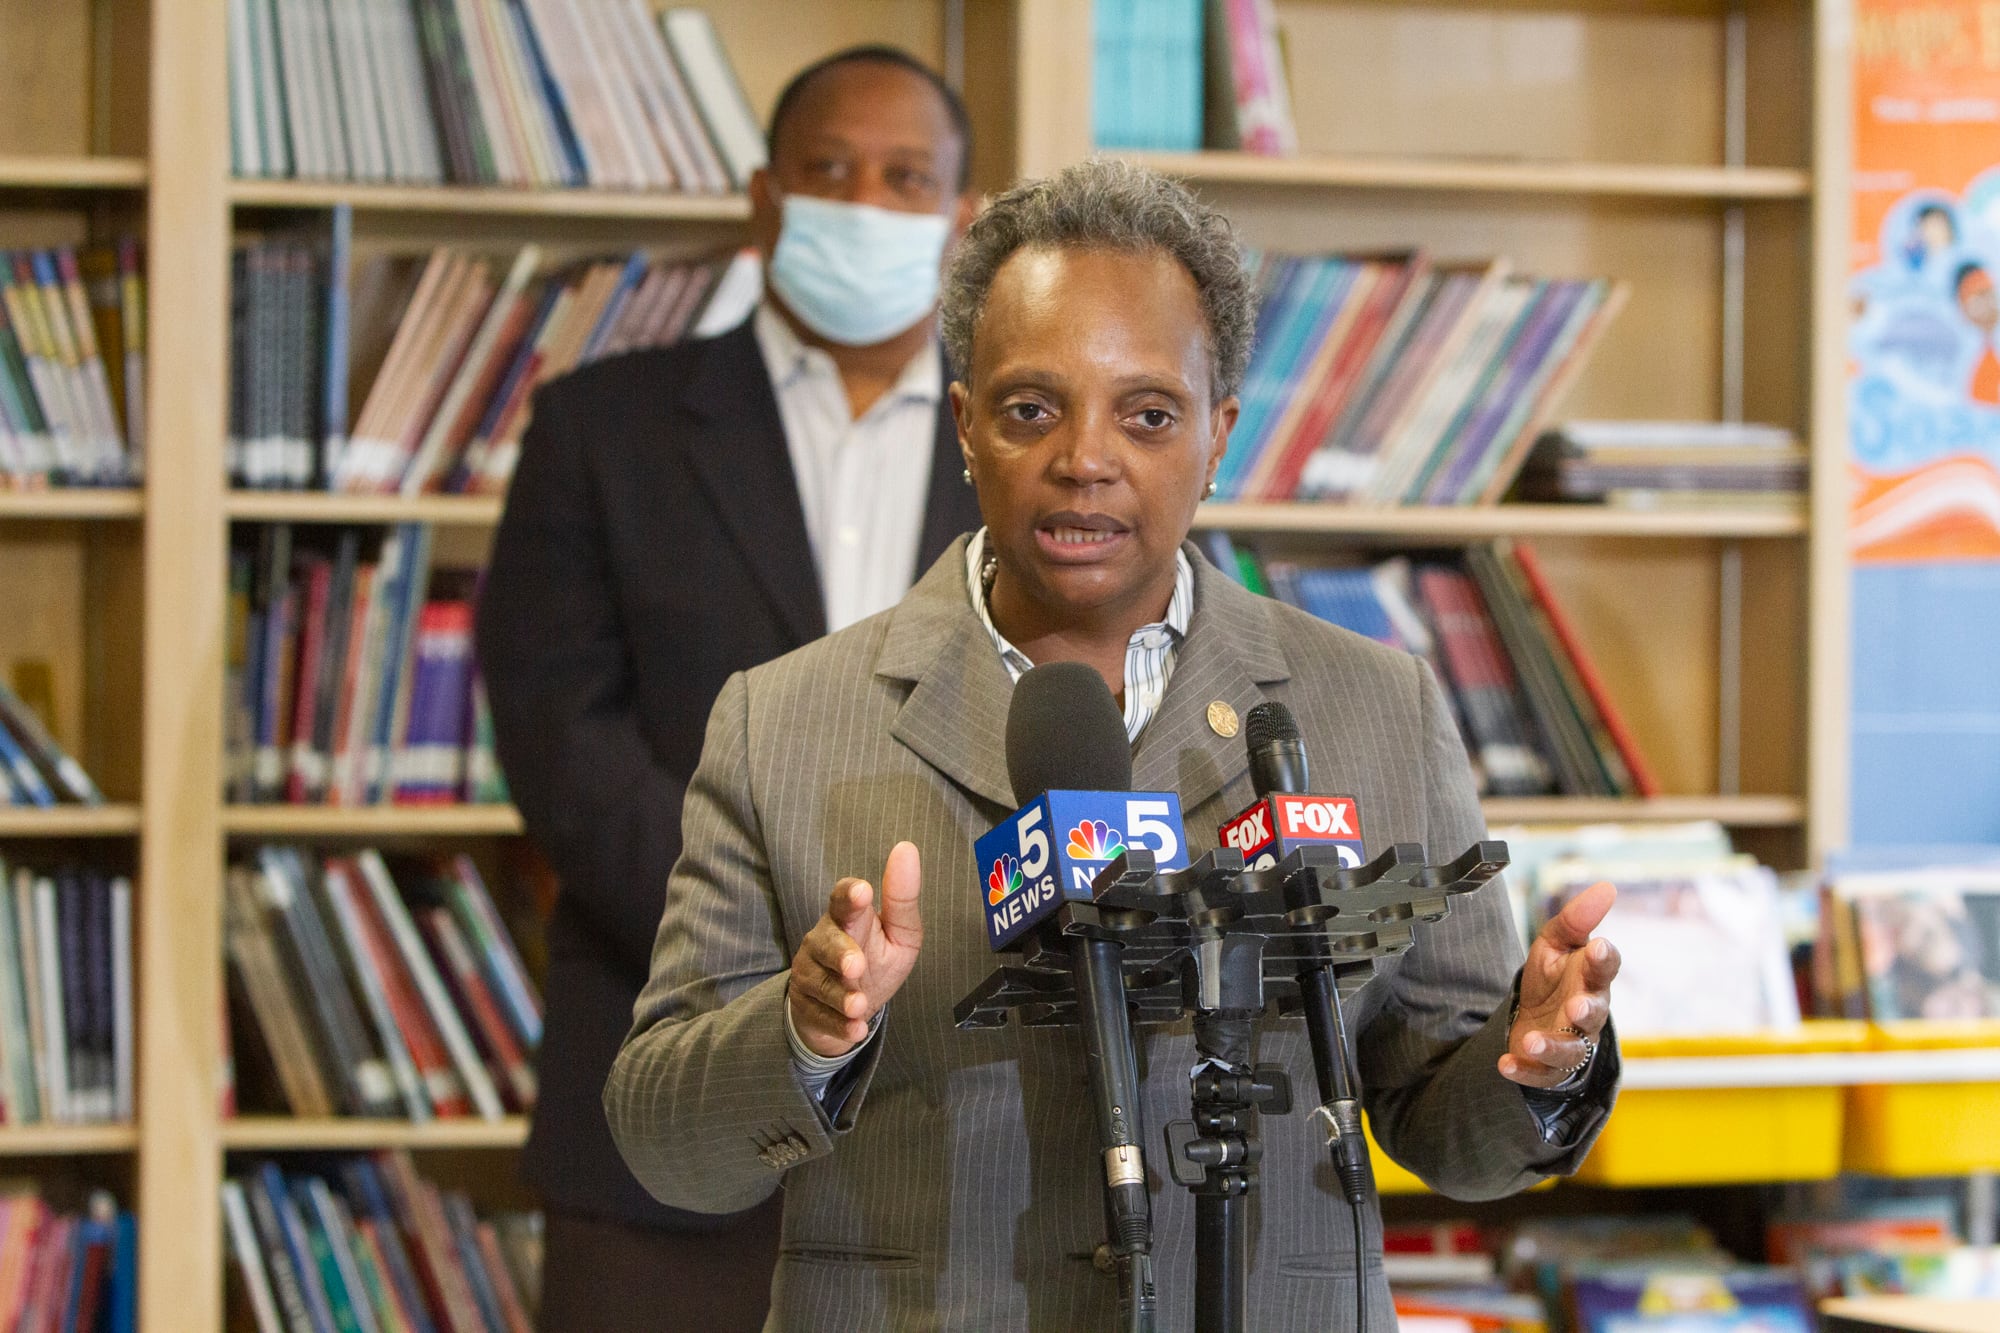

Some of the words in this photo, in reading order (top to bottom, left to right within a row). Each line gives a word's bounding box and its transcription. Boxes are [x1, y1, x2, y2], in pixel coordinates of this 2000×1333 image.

[1017, 805, 1049, 879] 5
[1126, 800, 1178, 864] 5
[1226, 807, 1269, 851] FOX
[1285, 801, 1353, 835] FOX
[993, 874, 1055, 936] NEWS
